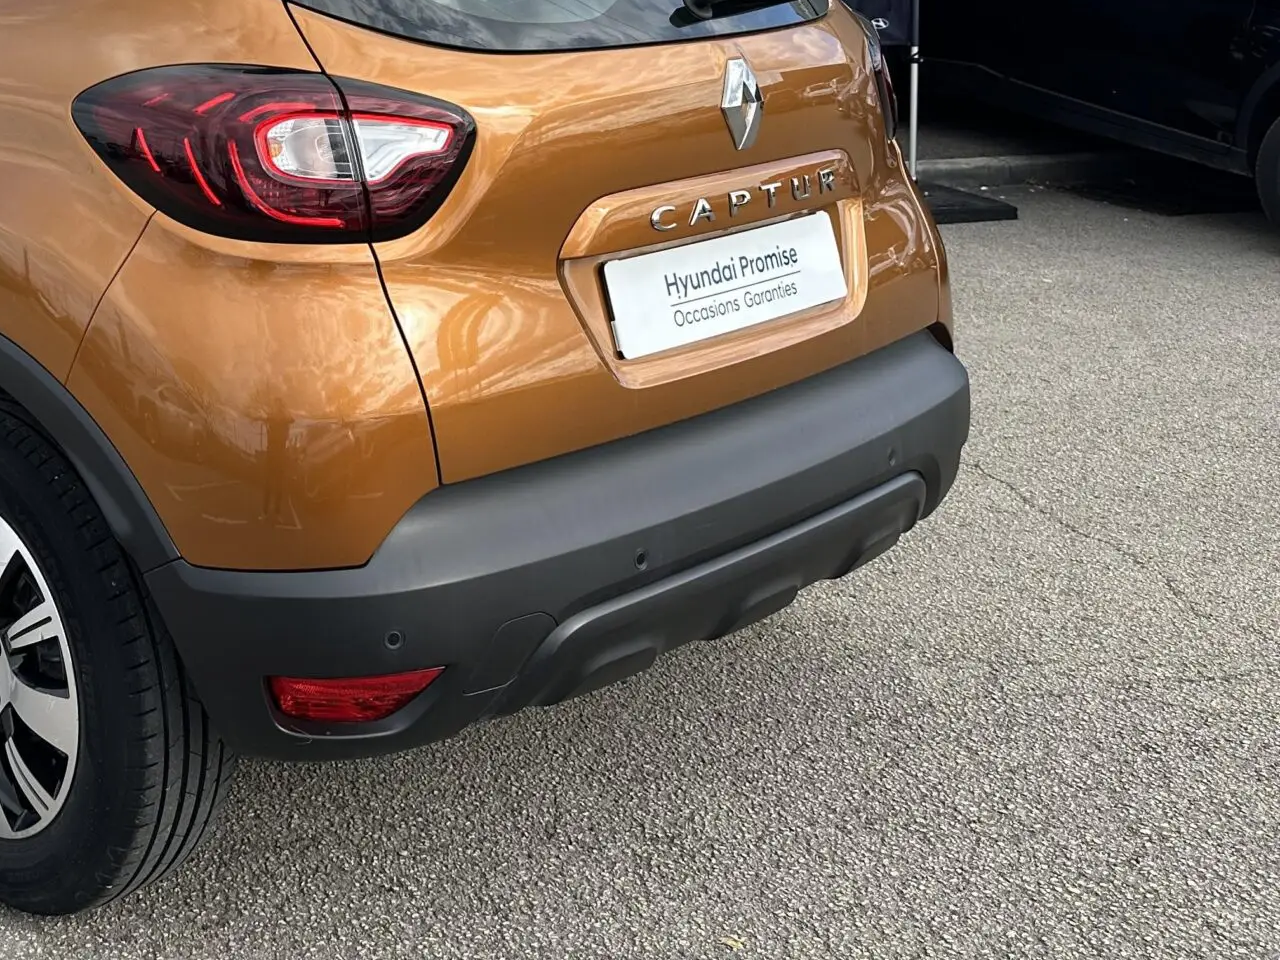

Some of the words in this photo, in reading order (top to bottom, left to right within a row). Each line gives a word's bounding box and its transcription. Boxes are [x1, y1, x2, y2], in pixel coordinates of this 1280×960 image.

[650, 168, 836, 232] CAPTUR
[664, 249, 737, 299] Hyundai
[739, 245, 799, 278] Promise
[673, 293, 740, 327] Occasions
[743, 280, 798, 308] Garanties
